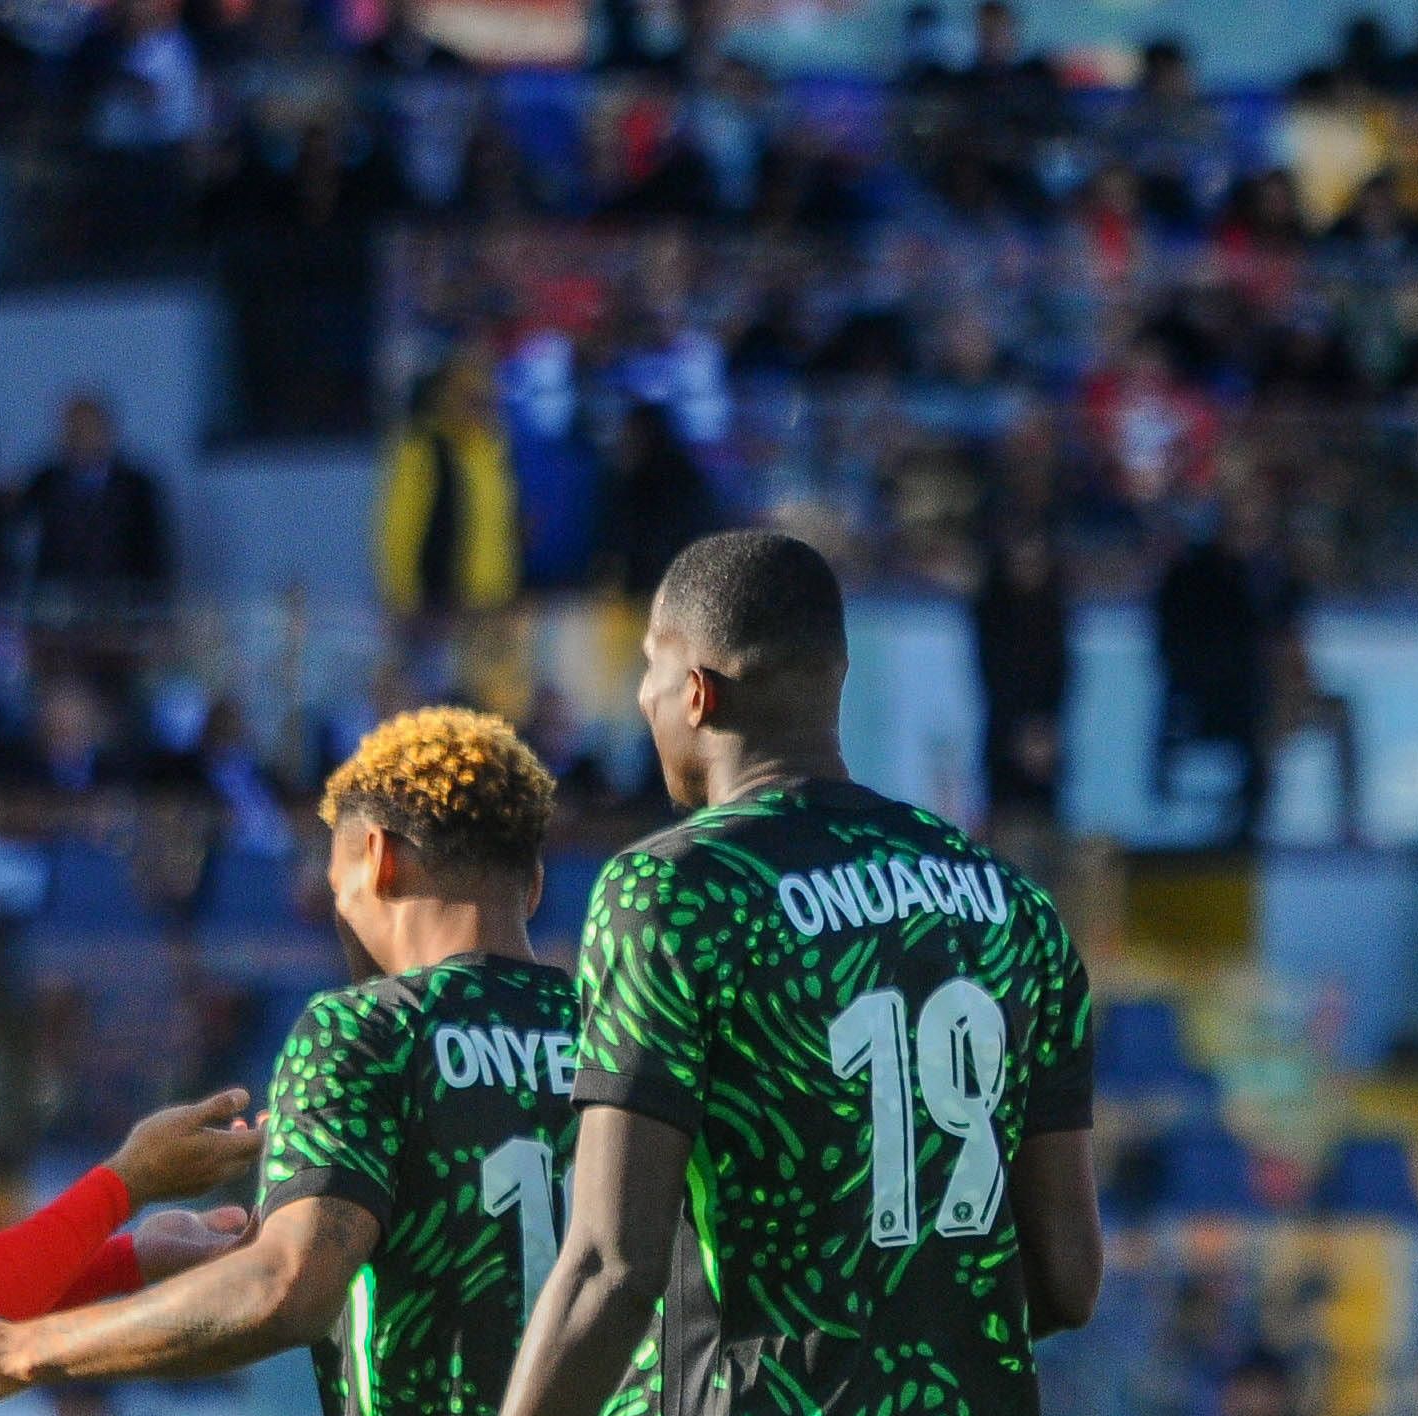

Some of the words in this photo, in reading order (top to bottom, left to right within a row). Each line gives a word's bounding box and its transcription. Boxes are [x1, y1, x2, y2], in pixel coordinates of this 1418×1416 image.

[779, 858, 1007, 935] ONUACHU
[829, 980, 1006, 1247] 19
[482, 1137, 575, 1331] 1
